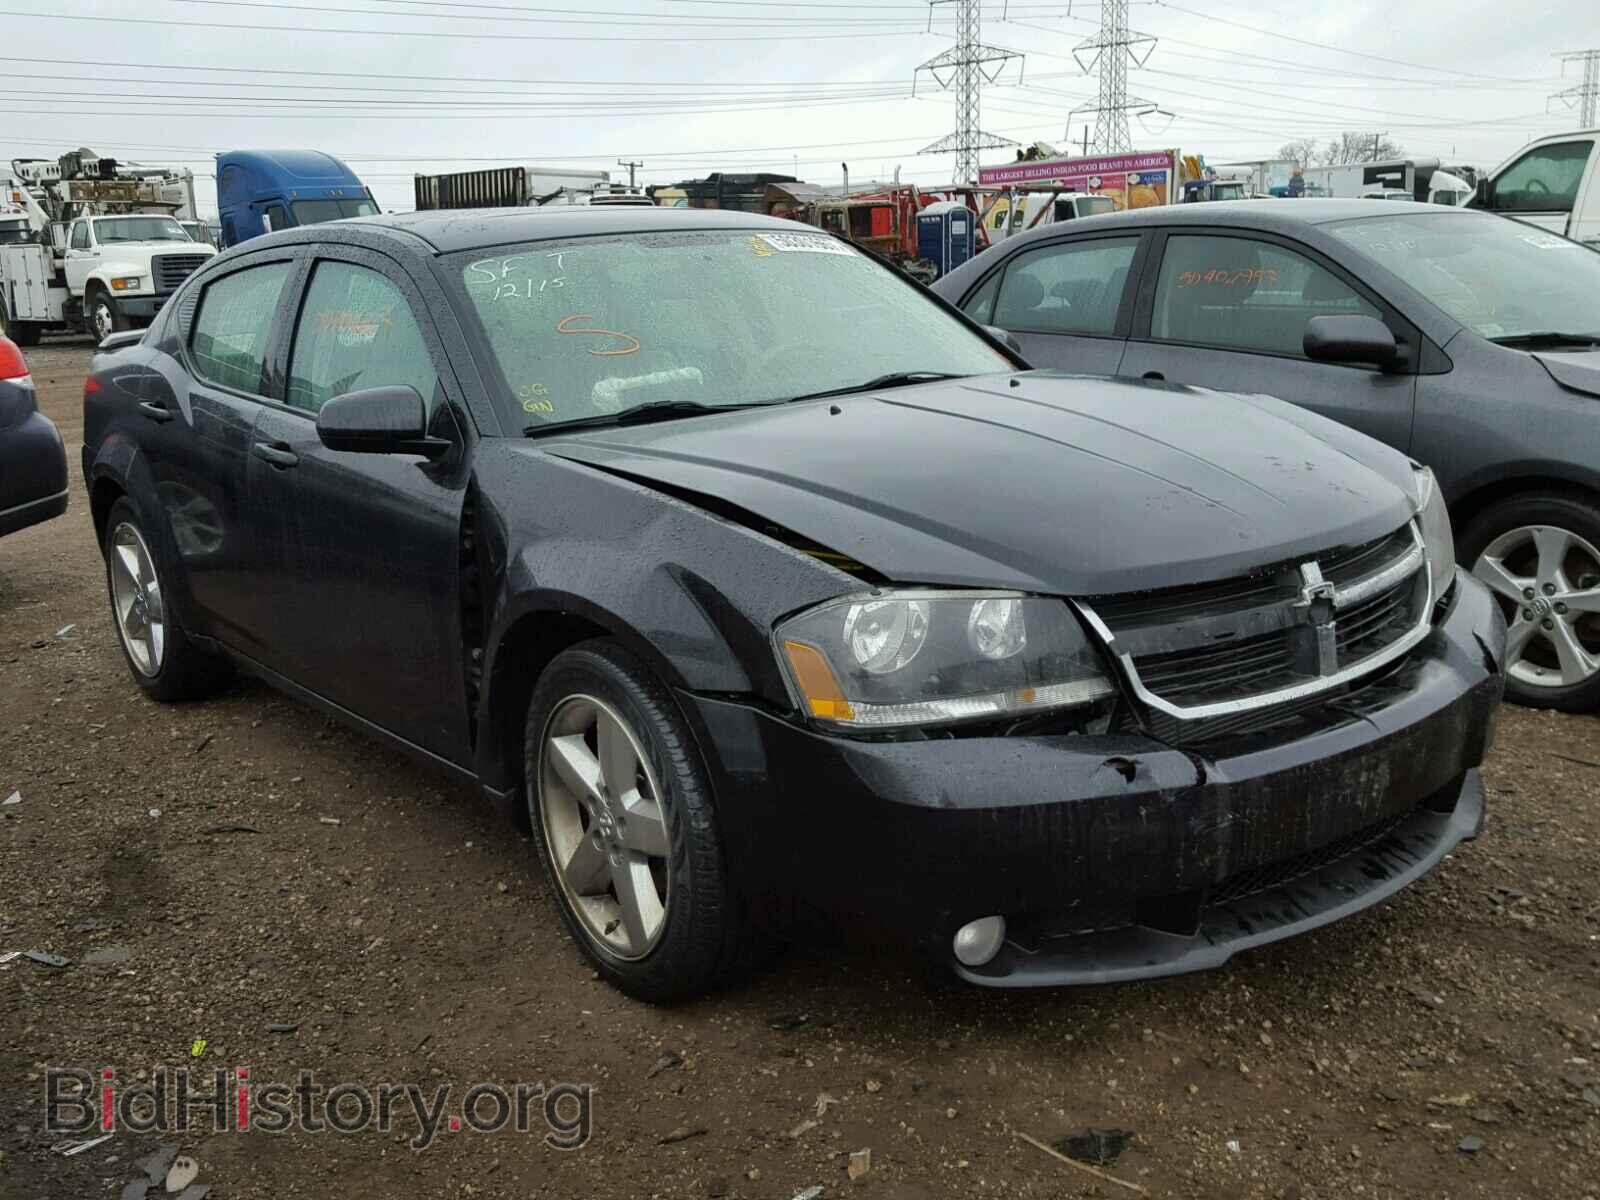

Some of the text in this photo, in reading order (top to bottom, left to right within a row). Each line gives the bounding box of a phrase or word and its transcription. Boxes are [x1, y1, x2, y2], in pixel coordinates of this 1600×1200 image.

[982, 156, 1169, 182] THE LARGEST SELLING INDIAN FOOD BRAND IN AMERICA
